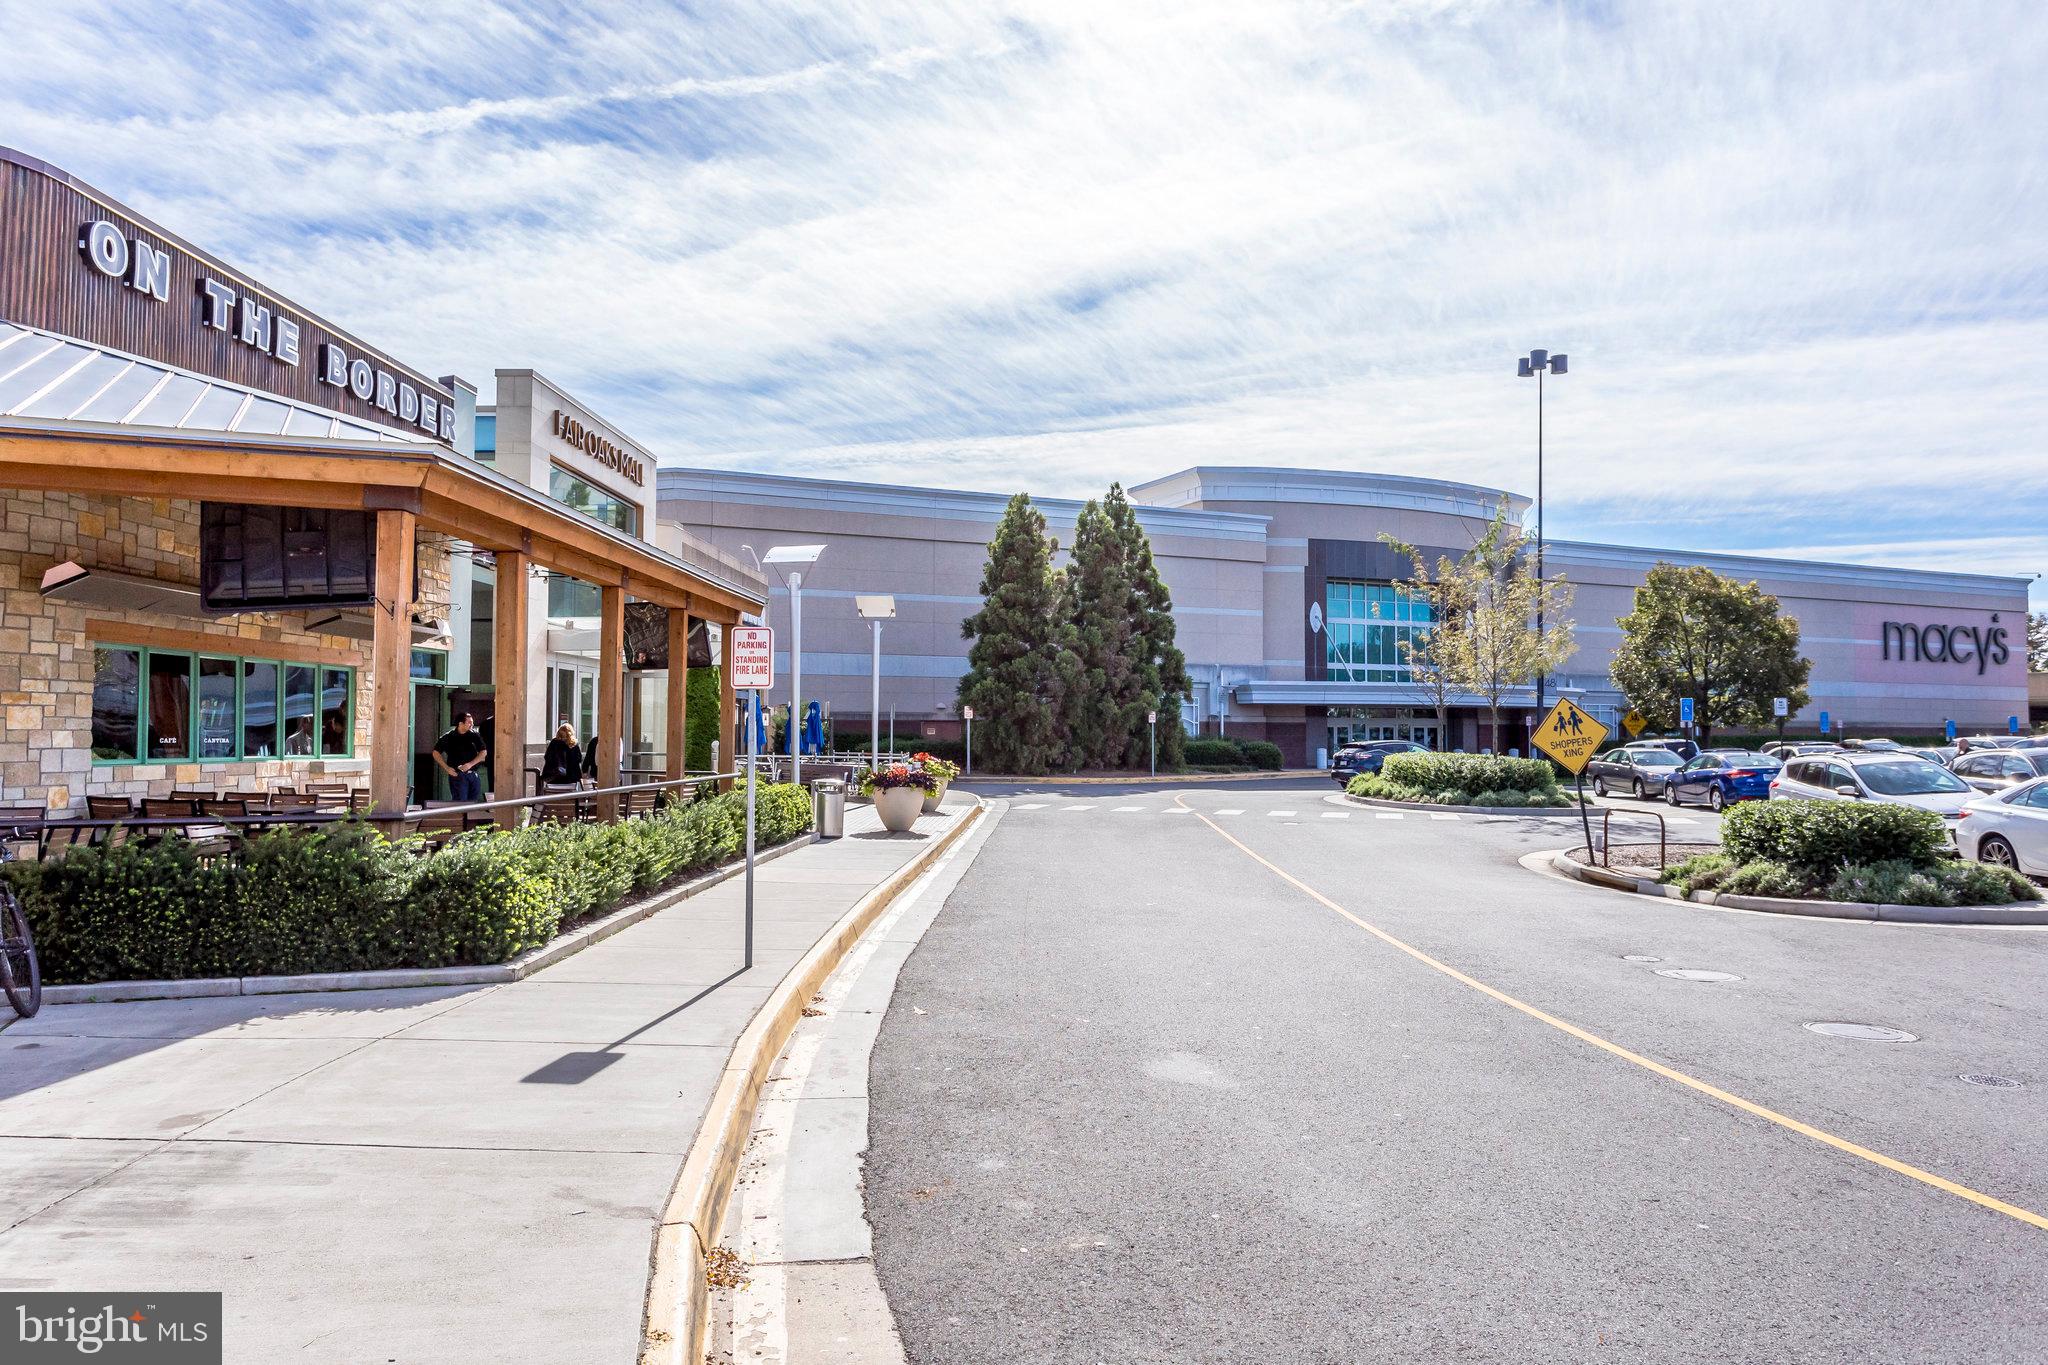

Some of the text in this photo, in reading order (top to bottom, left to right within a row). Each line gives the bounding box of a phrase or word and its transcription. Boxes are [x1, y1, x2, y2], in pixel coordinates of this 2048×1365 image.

[79, 221, 457, 442] ON THE BORDER
[553, 409, 583, 450] FAIR
[584, 430, 617, 469] OAKS
[747, 632, 757, 640] NO
[737, 641, 767, 649] PARKING
[735, 656, 768, 664] STANDING
[736, 666, 767, 674] FIRE LANE
[1550, 737, 1593, 749] SHOPPERS
[1563, 747, 1584, 758] XING
